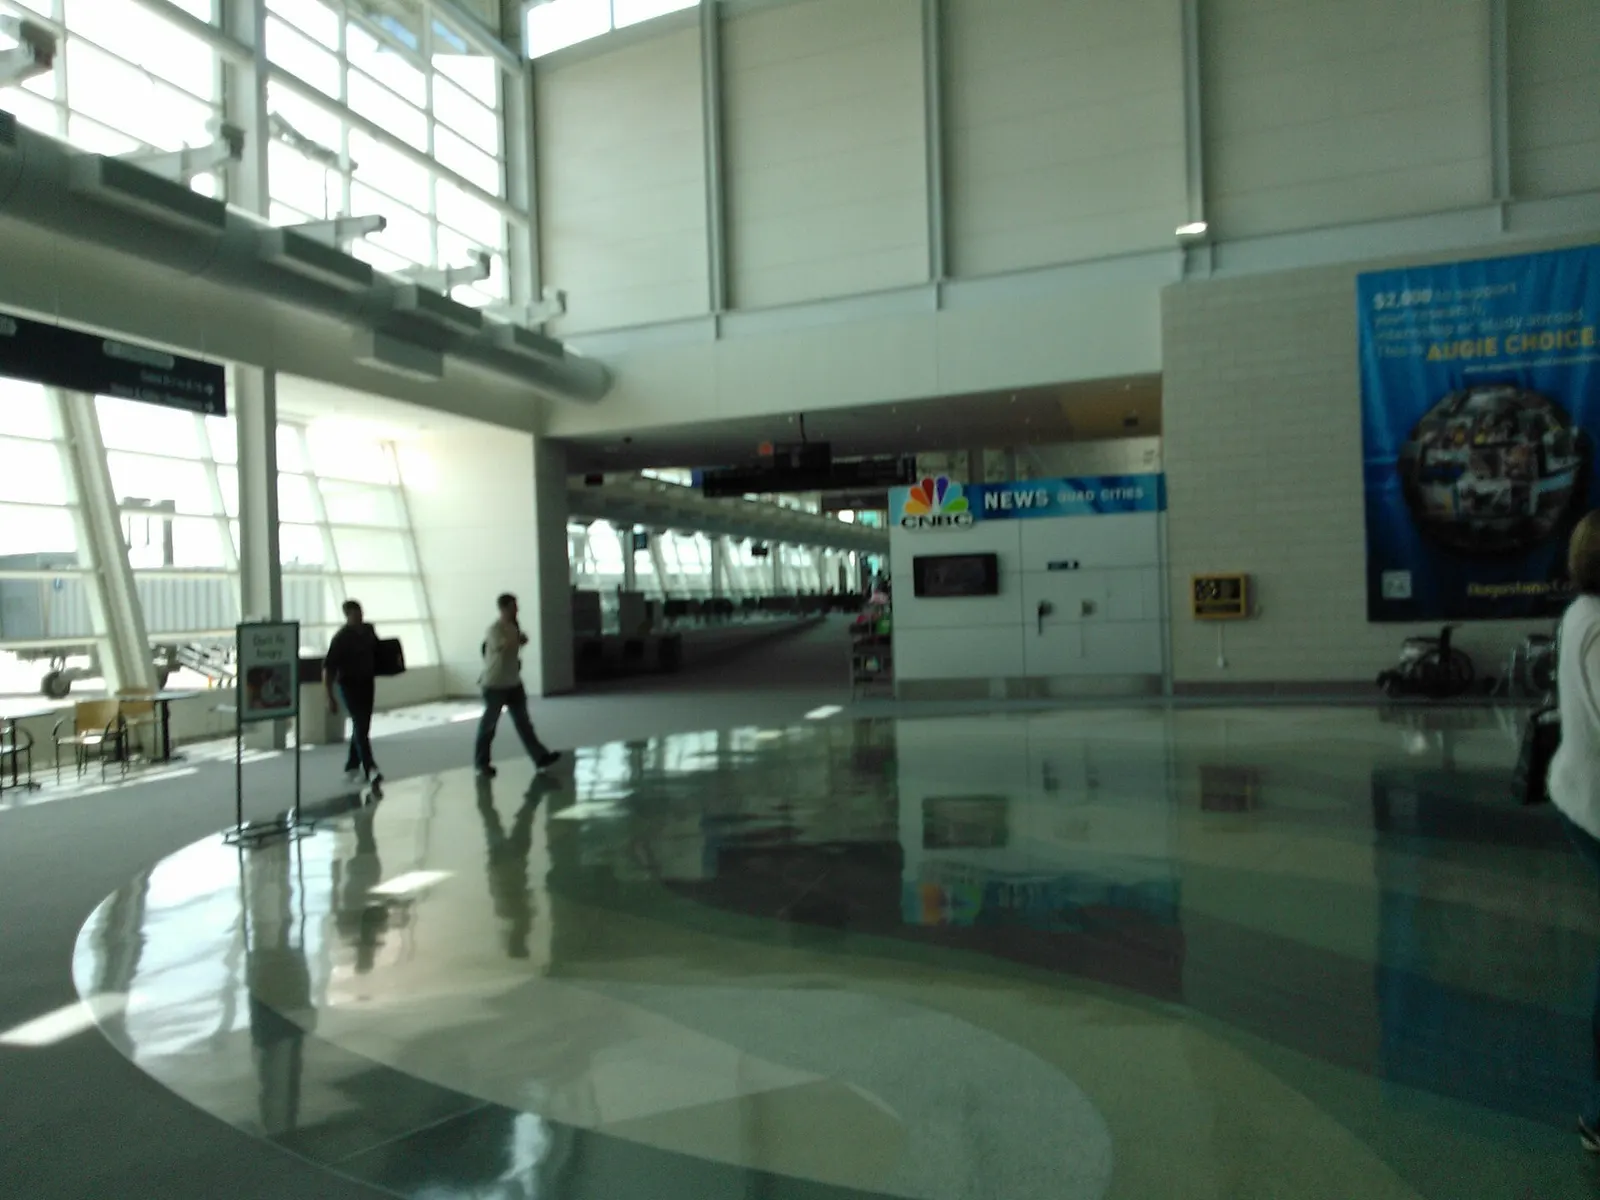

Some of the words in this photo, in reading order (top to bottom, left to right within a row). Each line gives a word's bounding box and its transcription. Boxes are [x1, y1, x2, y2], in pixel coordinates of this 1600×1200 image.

[1426, 336, 1498, 361] AUGIE
[984, 490, 1049, 511] NEWS
[1057, 489, 1095, 502] QUAD
[1100, 486, 1144, 501] CITIES
[901, 514, 973, 529] CNBC
